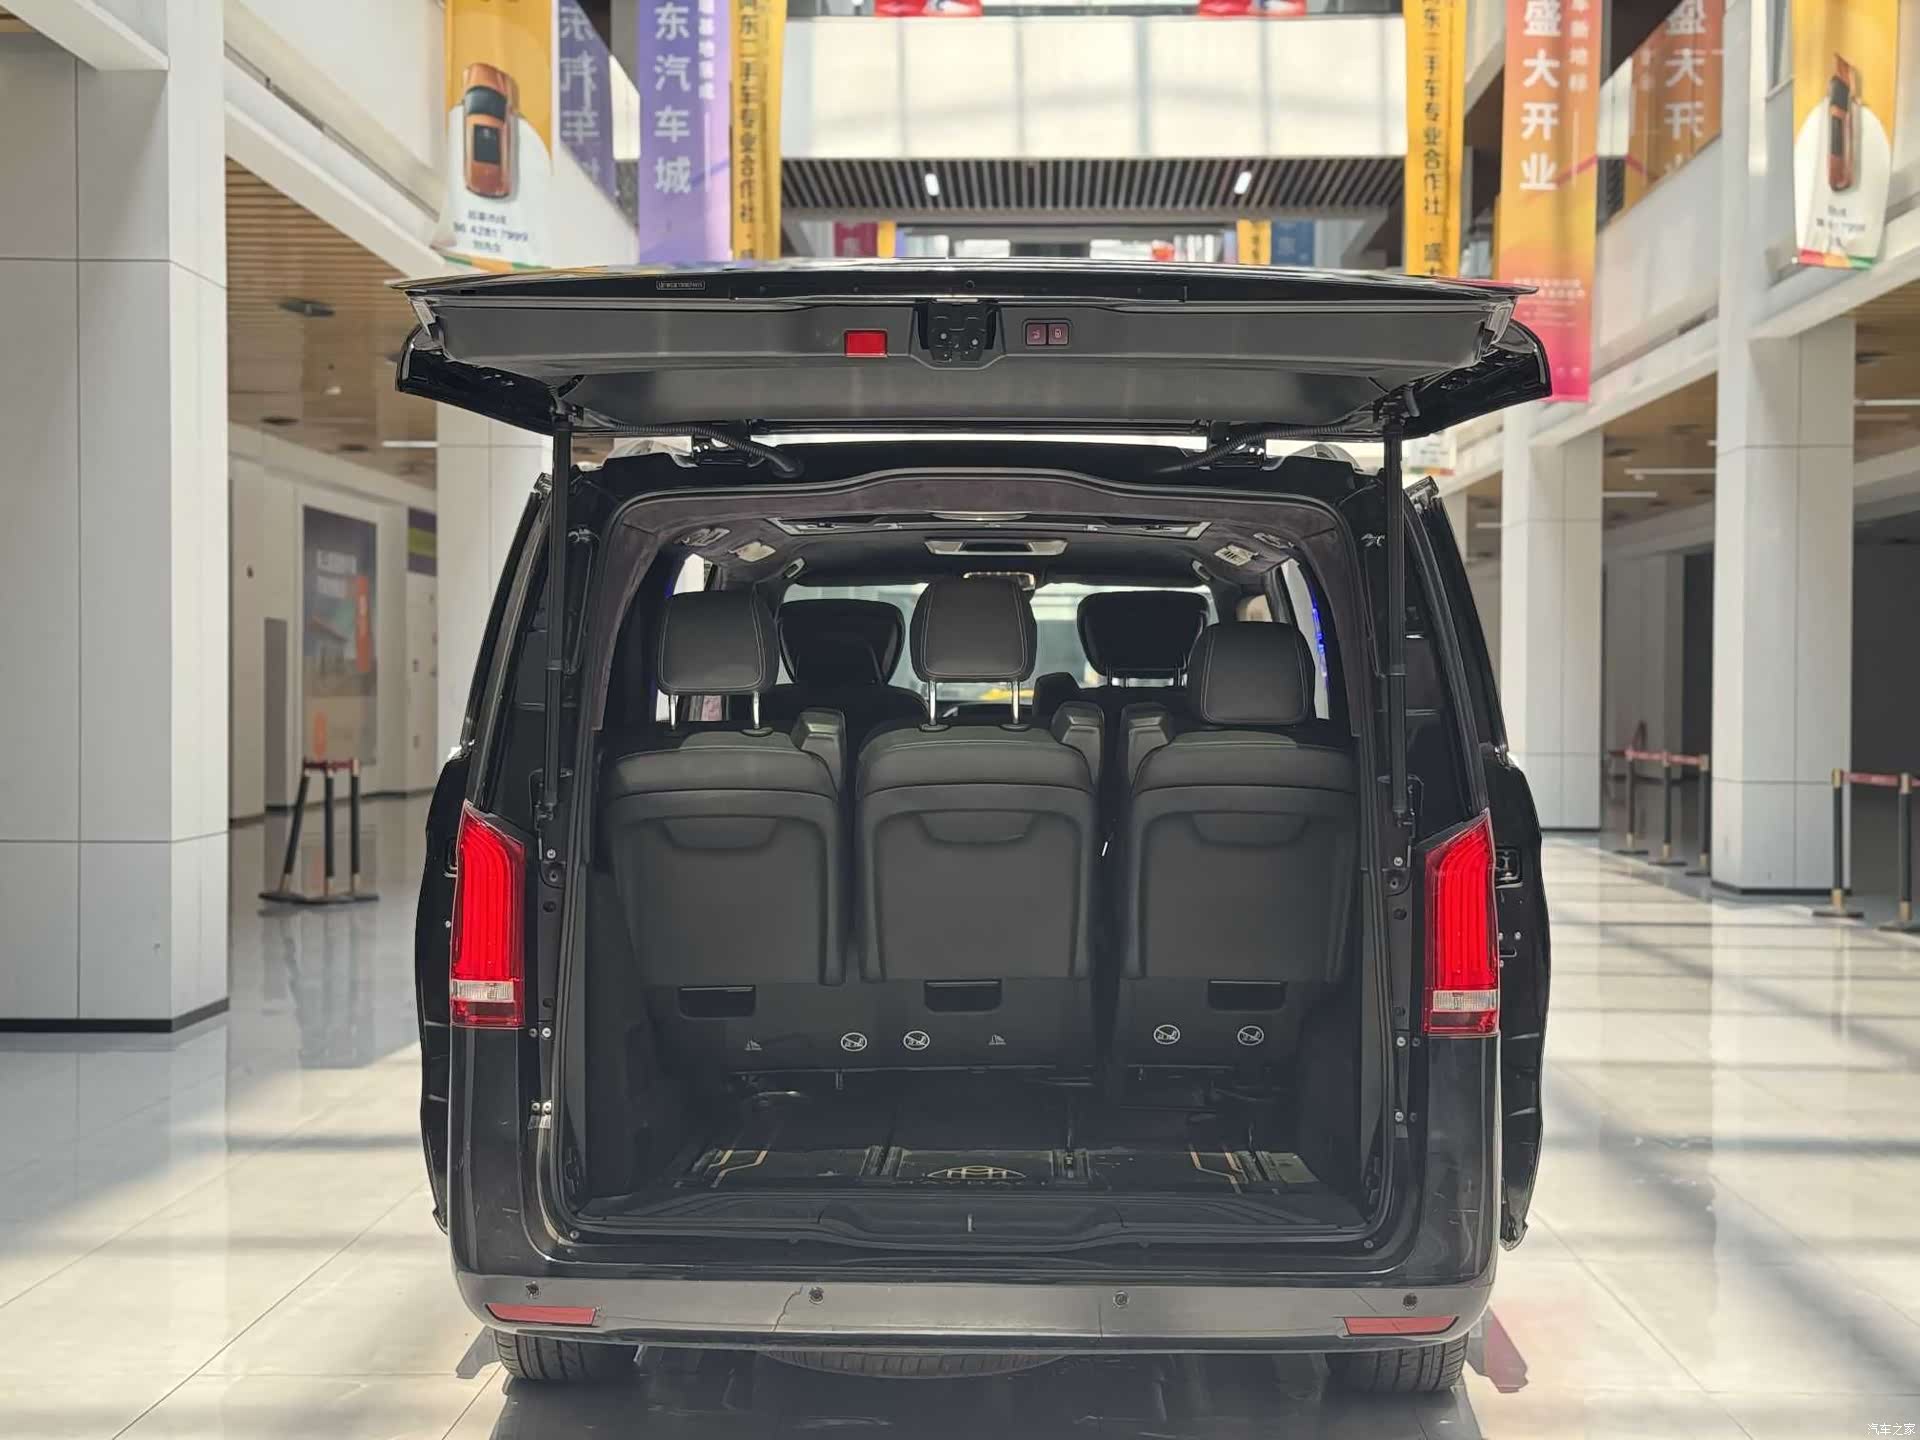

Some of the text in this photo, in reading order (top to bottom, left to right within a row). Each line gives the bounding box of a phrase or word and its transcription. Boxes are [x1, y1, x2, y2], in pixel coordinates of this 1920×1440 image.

[654, 1, 691, 195] 东汽车城
[1520, 0, 1561, 191] 盛大开业
